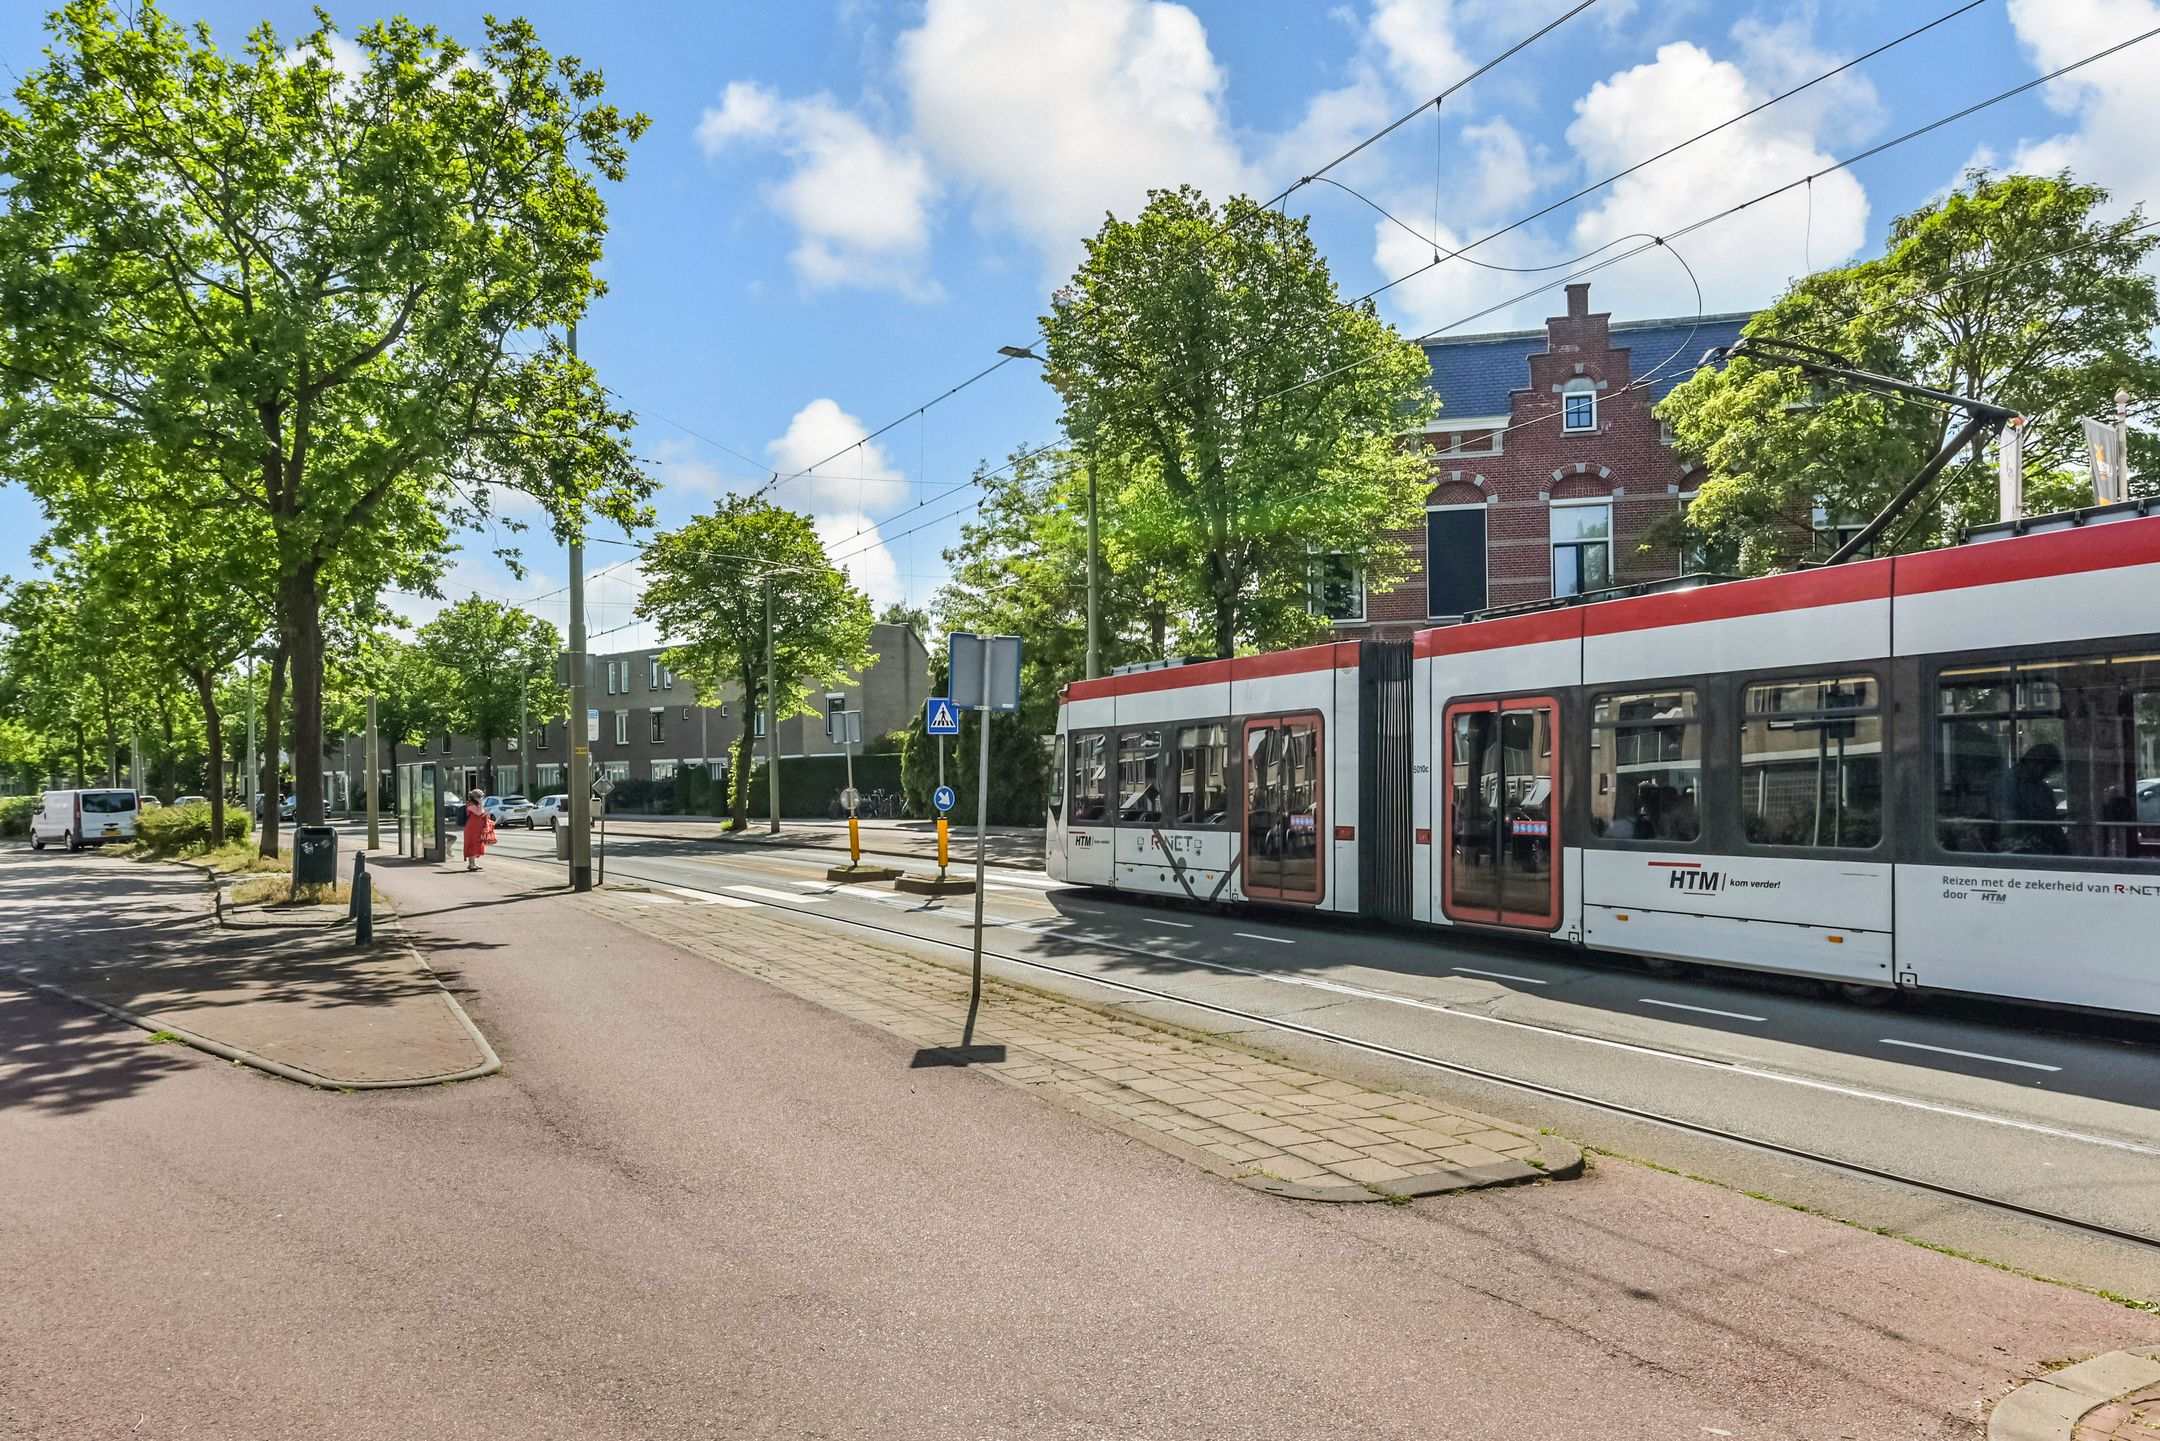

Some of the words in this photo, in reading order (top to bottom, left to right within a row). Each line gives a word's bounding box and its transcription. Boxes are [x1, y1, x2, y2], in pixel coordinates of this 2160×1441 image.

[1075, 835, 1091, 847] HTM
[1669, 870, 1719, 891] HTM
[1730, 878, 1748, 887] kom
[1751, 880, 1781, 889] verder!
[1943, 876, 1977, 886] Reizen
[1981, 879, 2004, 888] met
[2007, 878, 2021, 889] de
[2025, 880, 2083, 892] zekerheid
[2088, 884, 2110, 893] van
[1943, 889, 1968, 899] door
[1981, 893, 2007, 902] HTM
